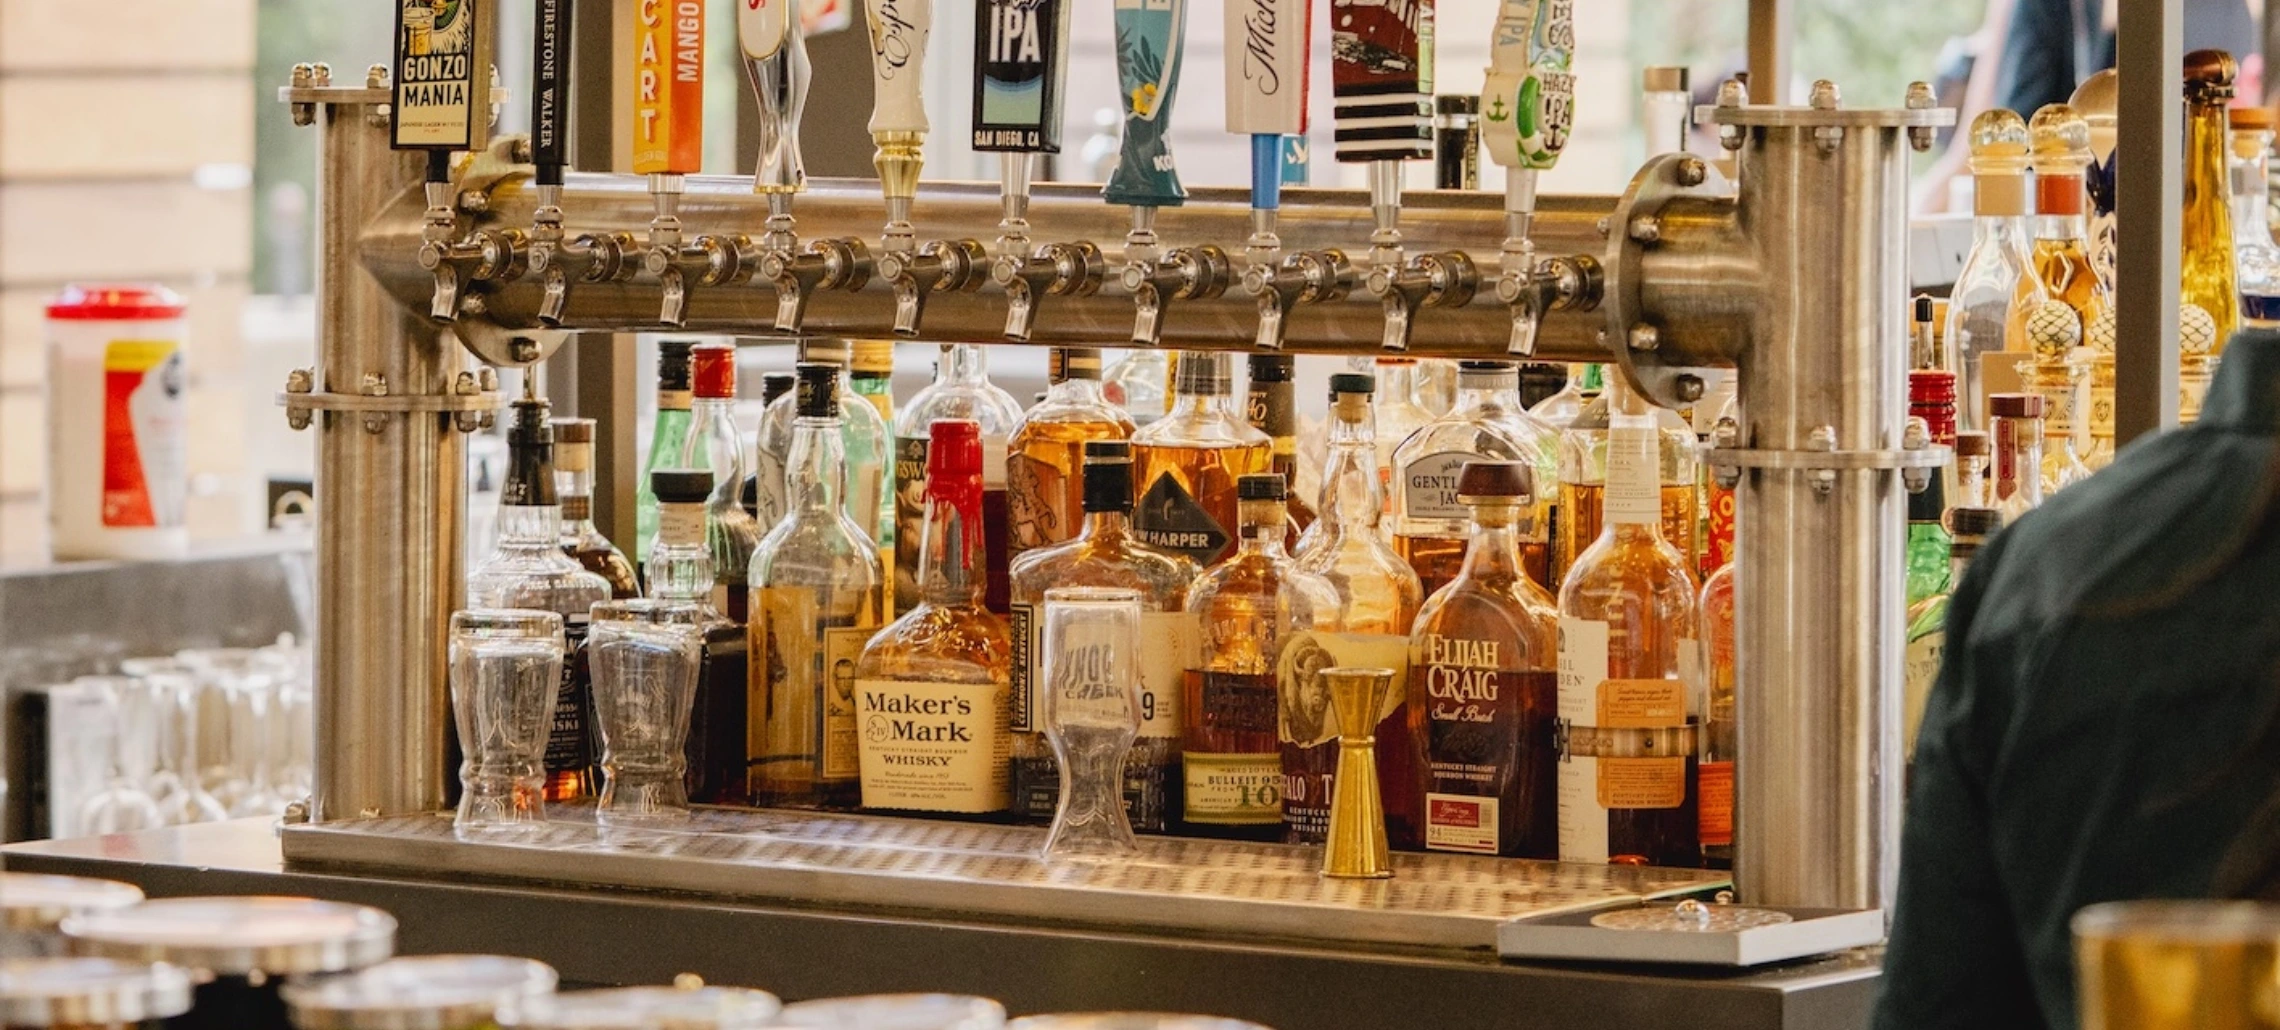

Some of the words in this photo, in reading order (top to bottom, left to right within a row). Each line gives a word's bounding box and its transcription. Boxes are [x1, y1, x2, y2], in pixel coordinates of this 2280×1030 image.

[543, 0, 556, 81] FIRESTONE
[677, 2, 700, 82] MANGO
[989, 5, 1041, 63] IPA
[404, 55, 466, 81] GONZO
[404, 83, 464, 107] MANIA
[540, 88, 554, 148] WALKER
[974, 130, 993, 146] SAN
[1027, 131, 1040, 147] CA
[1412, 474, 1458, 489] GENTL
[1440, 490, 1458, 506] JAC
[1149, 530, 1209, 548] HARPER
[1428, 633, 1499, 672] ELIJAH
[1427, 666, 1498, 703] CRAIG
[864, 691, 972, 716] Maker's
[1142, 691, 1155, 721] 9
[891, 719, 972, 743] Mark
[883, 754, 953, 767] WHISKY
[1208, 775, 1257, 786] BULLEIT
[1238, 785, 1279, 806] 10
